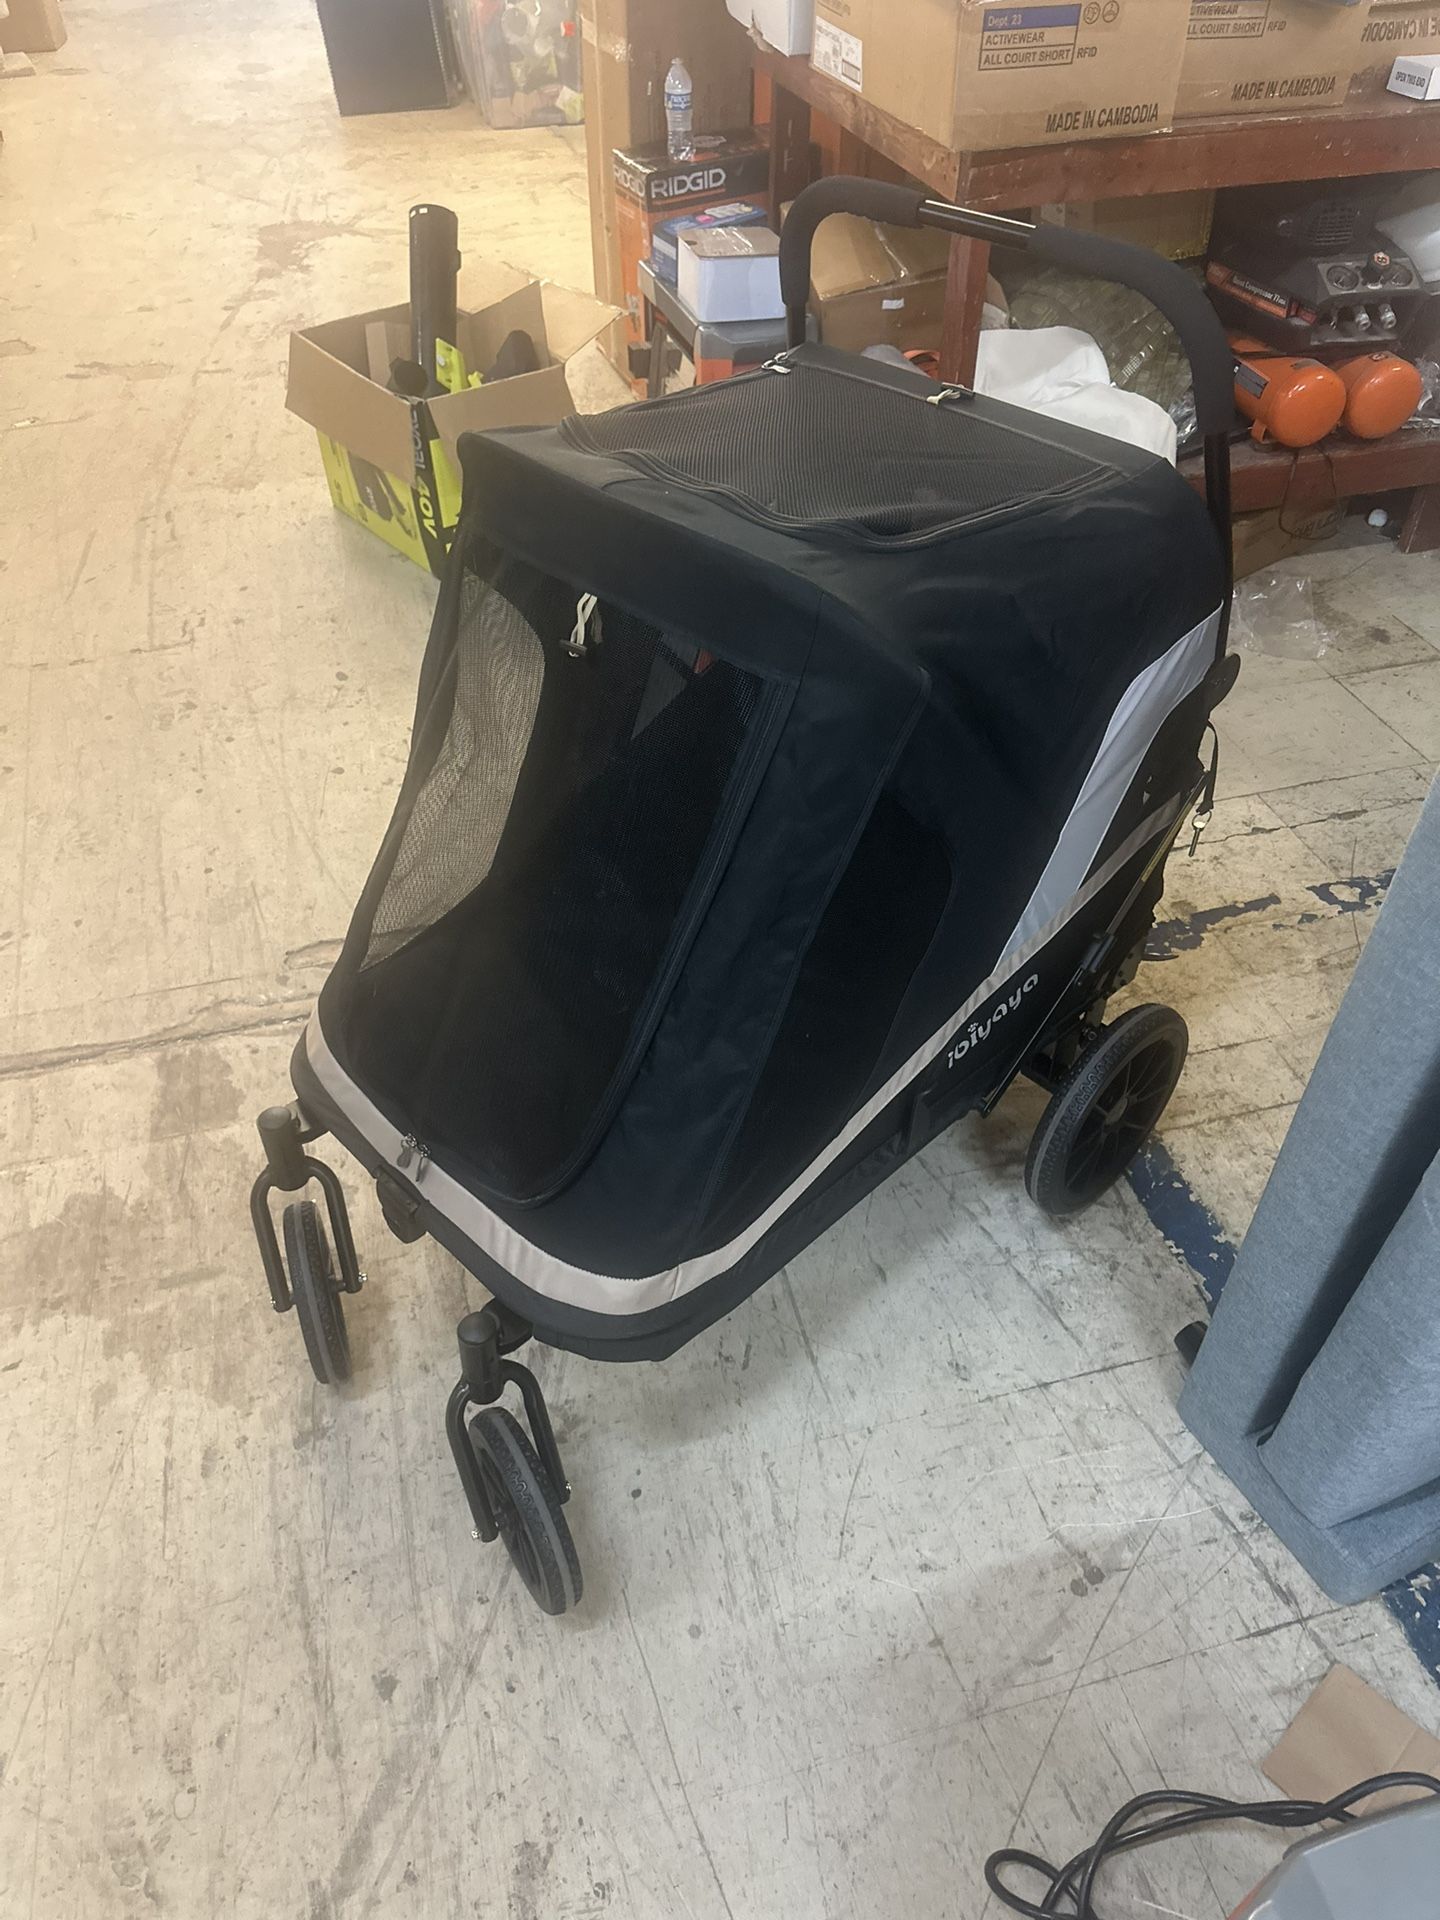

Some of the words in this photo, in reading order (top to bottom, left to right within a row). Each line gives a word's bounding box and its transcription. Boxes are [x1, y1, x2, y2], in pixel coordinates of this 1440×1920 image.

[1190, 5, 1239, 17] TIVEWEAR
[1011, 13, 1022, 26] 23
[1267, 20, 1287, 32] RFID
[1187, 23, 1198, 36] LL
[1200, 22, 1231, 35] COURT
[1232, 21, 1262, 34] SHORT
[985, 31, 1046, 47] ACTIVEWEAR
[983, 53, 1002, 66] ALL
[1004, 51, 1038, 65] COURT
[1038, 49, 1072, 63] SHORT
[1076, 46, 1098, 60] RFID
[1231, 82, 1266, 101] MADE
[1265, 80, 1279, 99] IN
[1278, 76, 1336, 98] CAMBODIA
[1046, 111, 1080, 133] MADE
[1082, 109, 1097, 130] IN
[1097, 103, 1159, 128] CAMBODIA
[651, 168, 727, 199] RIDGID
[416, 475, 439, 540] 40V
